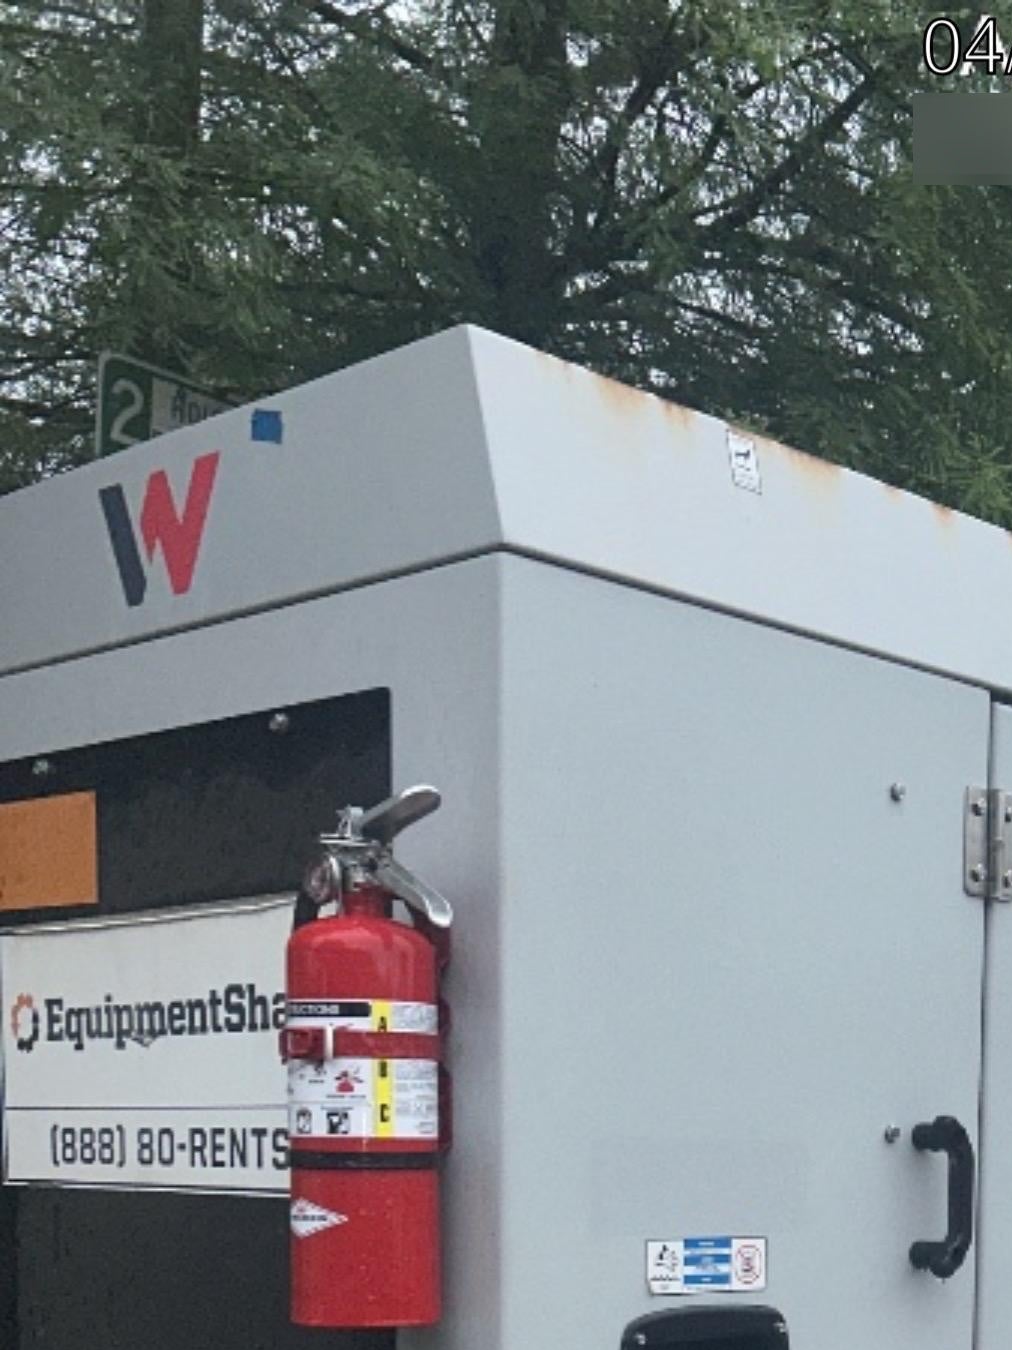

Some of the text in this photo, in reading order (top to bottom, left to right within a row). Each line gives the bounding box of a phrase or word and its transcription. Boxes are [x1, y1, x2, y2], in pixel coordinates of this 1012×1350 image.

[111, 378, 144, 444] 2
[50, 1124, 290, 1171] (888) 80-RENTS
